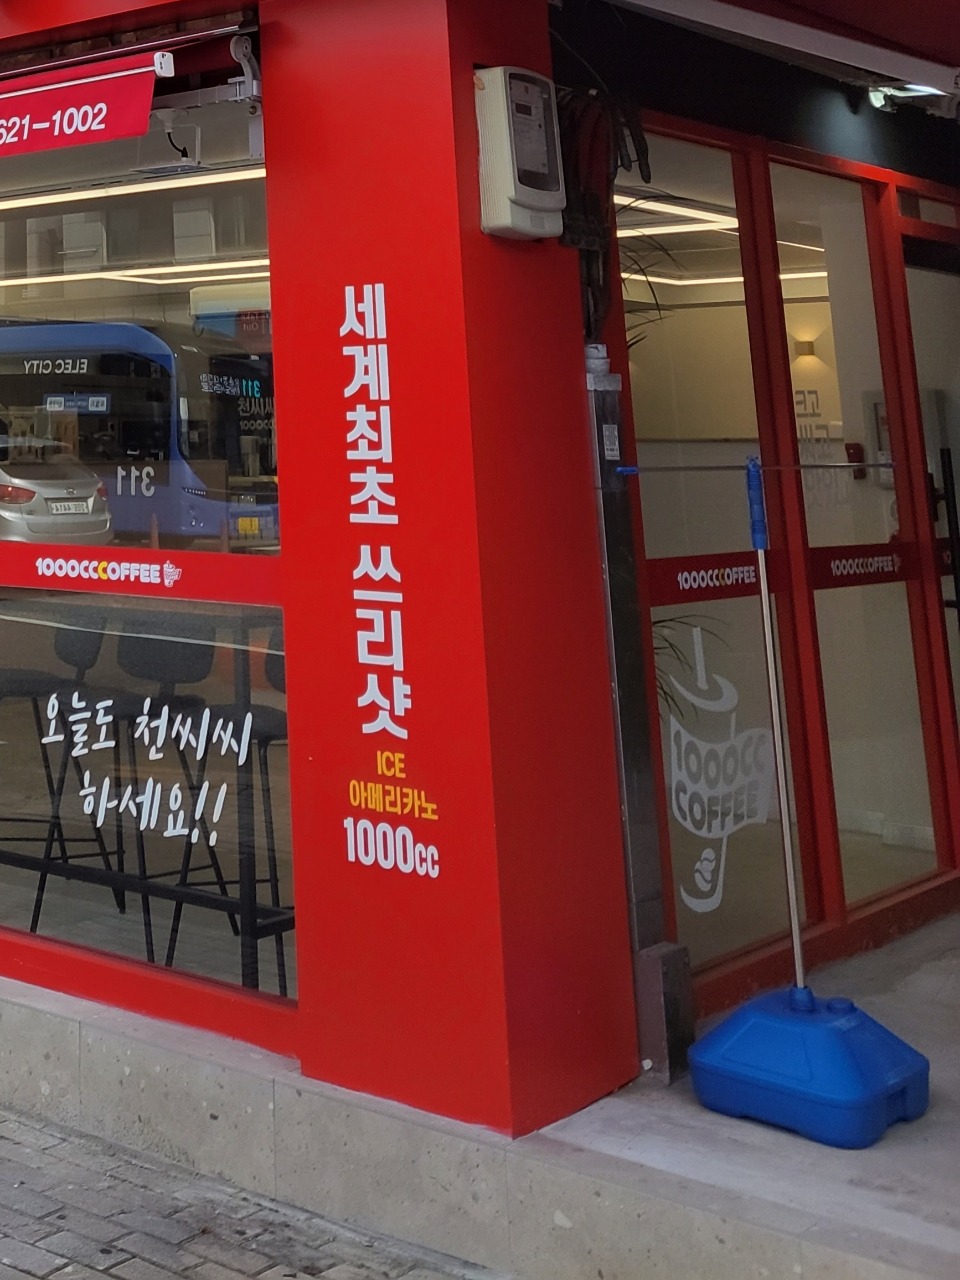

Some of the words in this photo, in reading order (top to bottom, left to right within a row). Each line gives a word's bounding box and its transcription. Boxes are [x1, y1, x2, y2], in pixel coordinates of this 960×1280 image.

[352, 543, 413, 741] 쓰리샷
[40, 690, 116, 758] 오늘도
[134, 696, 253, 767] 천씨씨
[672, 728, 768, 790] 1000CC
[376, 750, 406, 780] ICE
[79, 770, 228, 848] 하세요!!
[349, 777, 440, 821] 아메리카노
[673, 780, 759, 832] COFFEE
